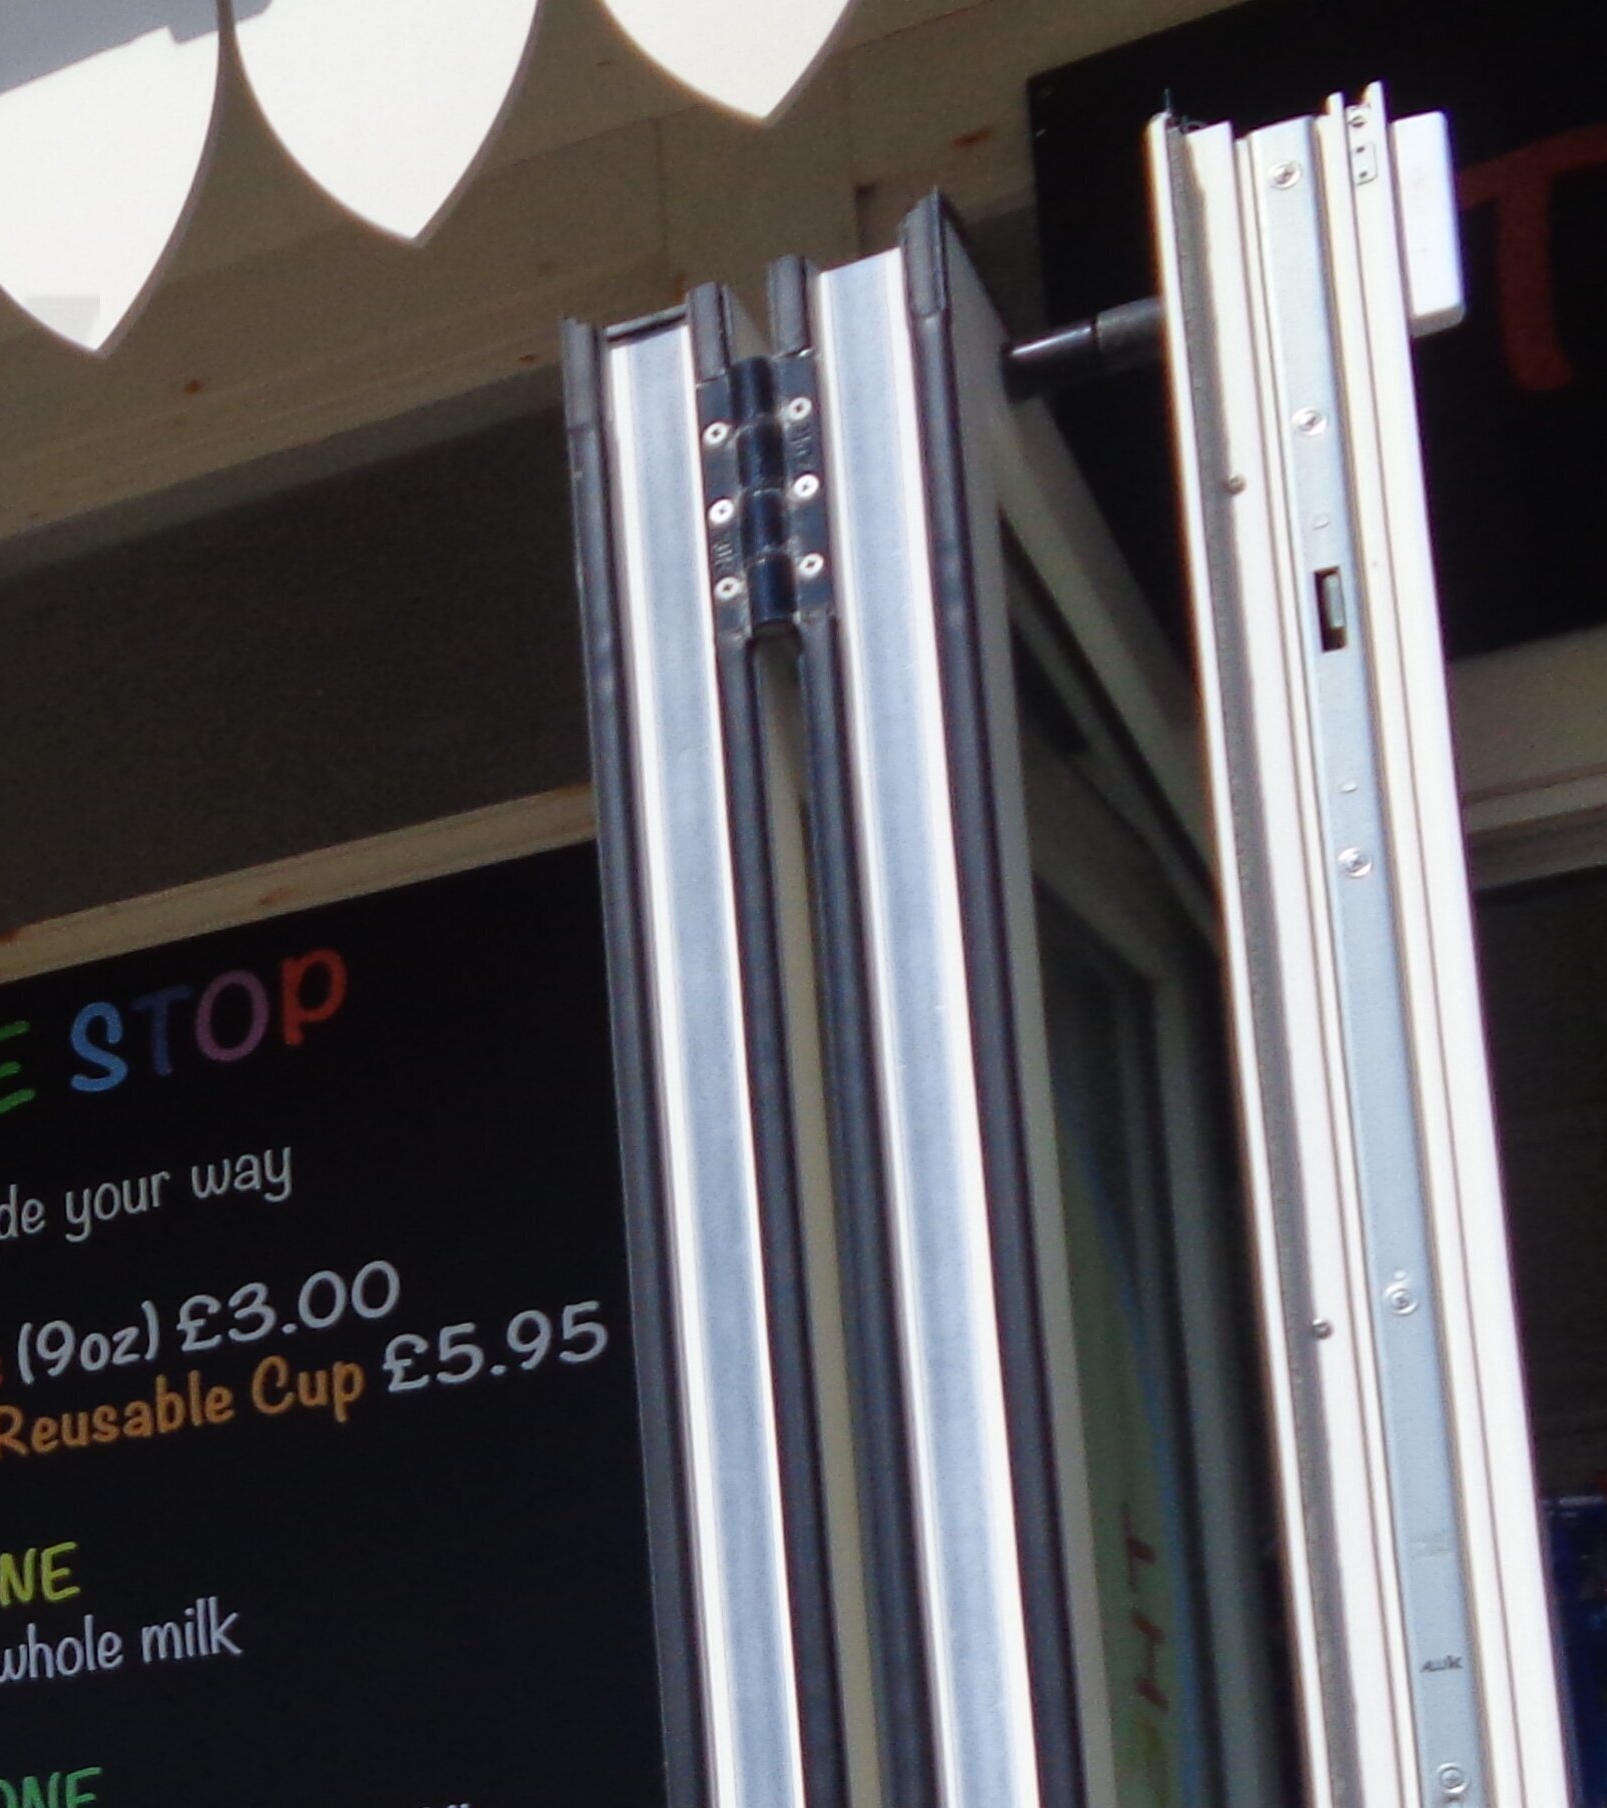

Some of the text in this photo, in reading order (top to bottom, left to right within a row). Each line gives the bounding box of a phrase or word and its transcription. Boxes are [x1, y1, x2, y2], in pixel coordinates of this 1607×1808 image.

[69, 948, 348, 1093] STOP
[64, 1170, 171, 1243] your
[191, 1146, 292, 1203] way
[17, 1300, 160, 1385] (9oz)
[176, 1260, 400, 1353] £3.00
[250, 1355, 365, 1423] Cup
[381, 1300, 609, 1393] £5.95
[141, 1595, 243, 1664] milk
